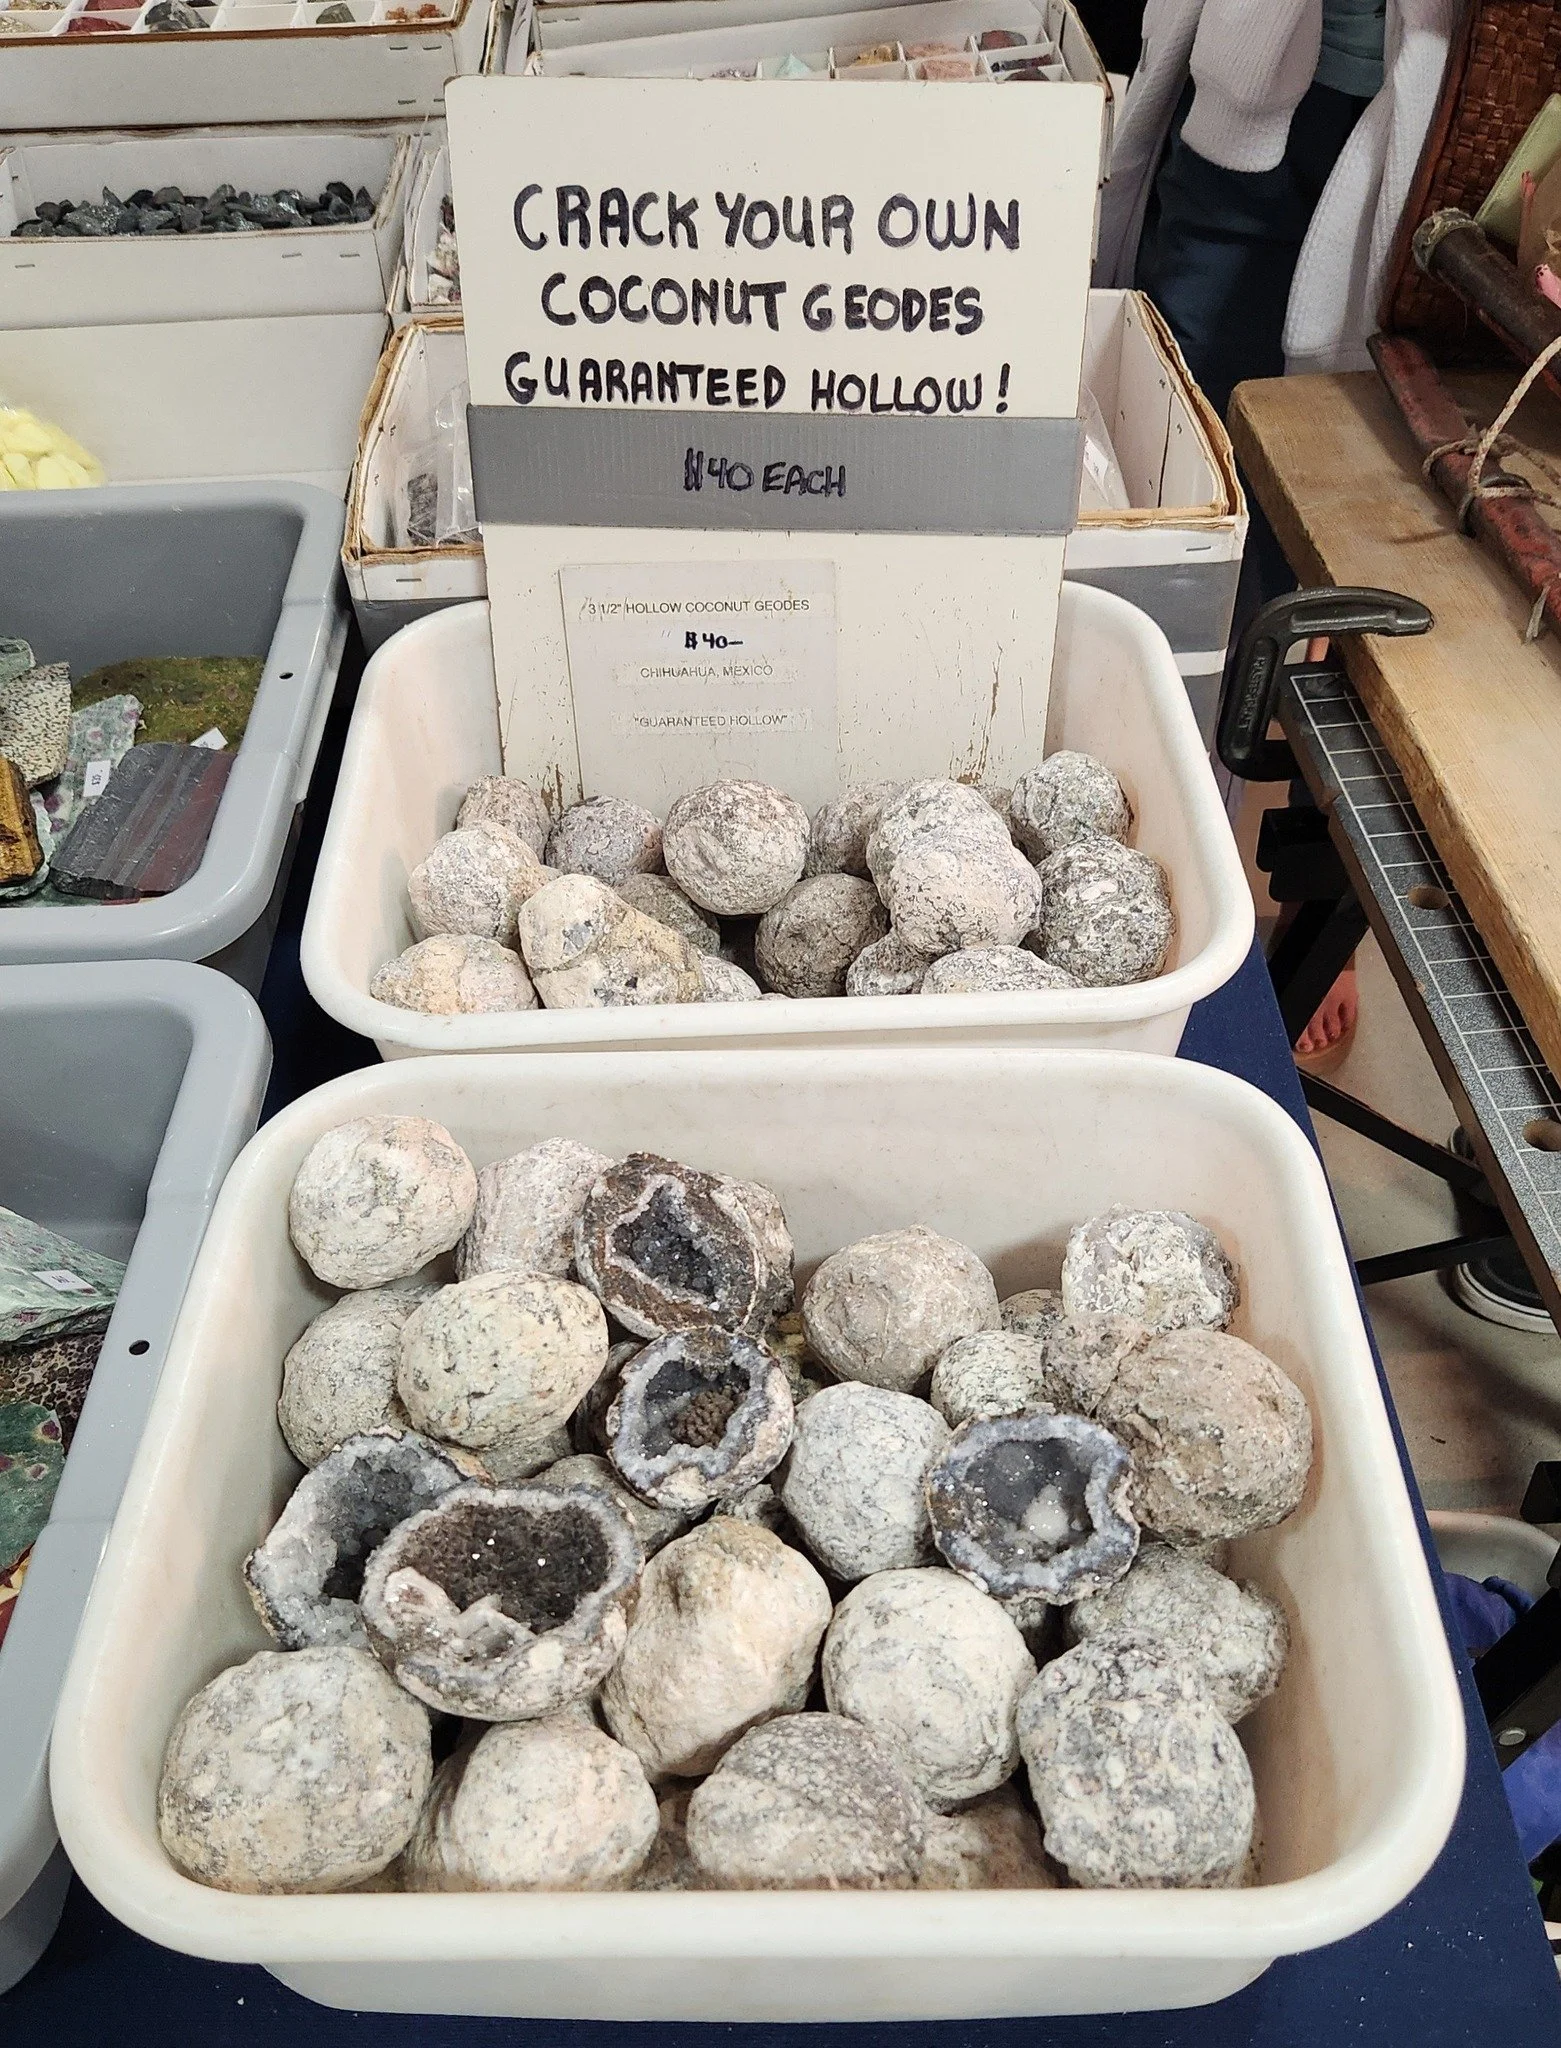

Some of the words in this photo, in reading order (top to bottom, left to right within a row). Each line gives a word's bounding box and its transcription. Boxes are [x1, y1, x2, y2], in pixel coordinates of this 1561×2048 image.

[513, 184, 700, 251] CRACK
[715, 191, 855, 254] YOUR
[877, 193, 1021, 252] OWN
[540, 272, 787, 332] COCONUT
[802, 283, 985, 336] GEODES
[504, 352, 786, 410] GUARANTEED
[762, 462, 847, 498] EACH
[626, 602, 682, 614] HOLLOW
[685, 600, 751, 613] COCONUT
[754, 599, 810, 612] GEODES
[640, 666, 720, 679] CHIHUAHUA,
[722, 665, 774, 678] MEXICO
[634, 716, 726, 728] "GUARANTEED
[729, 714, 788, 727] HOLLOW"
